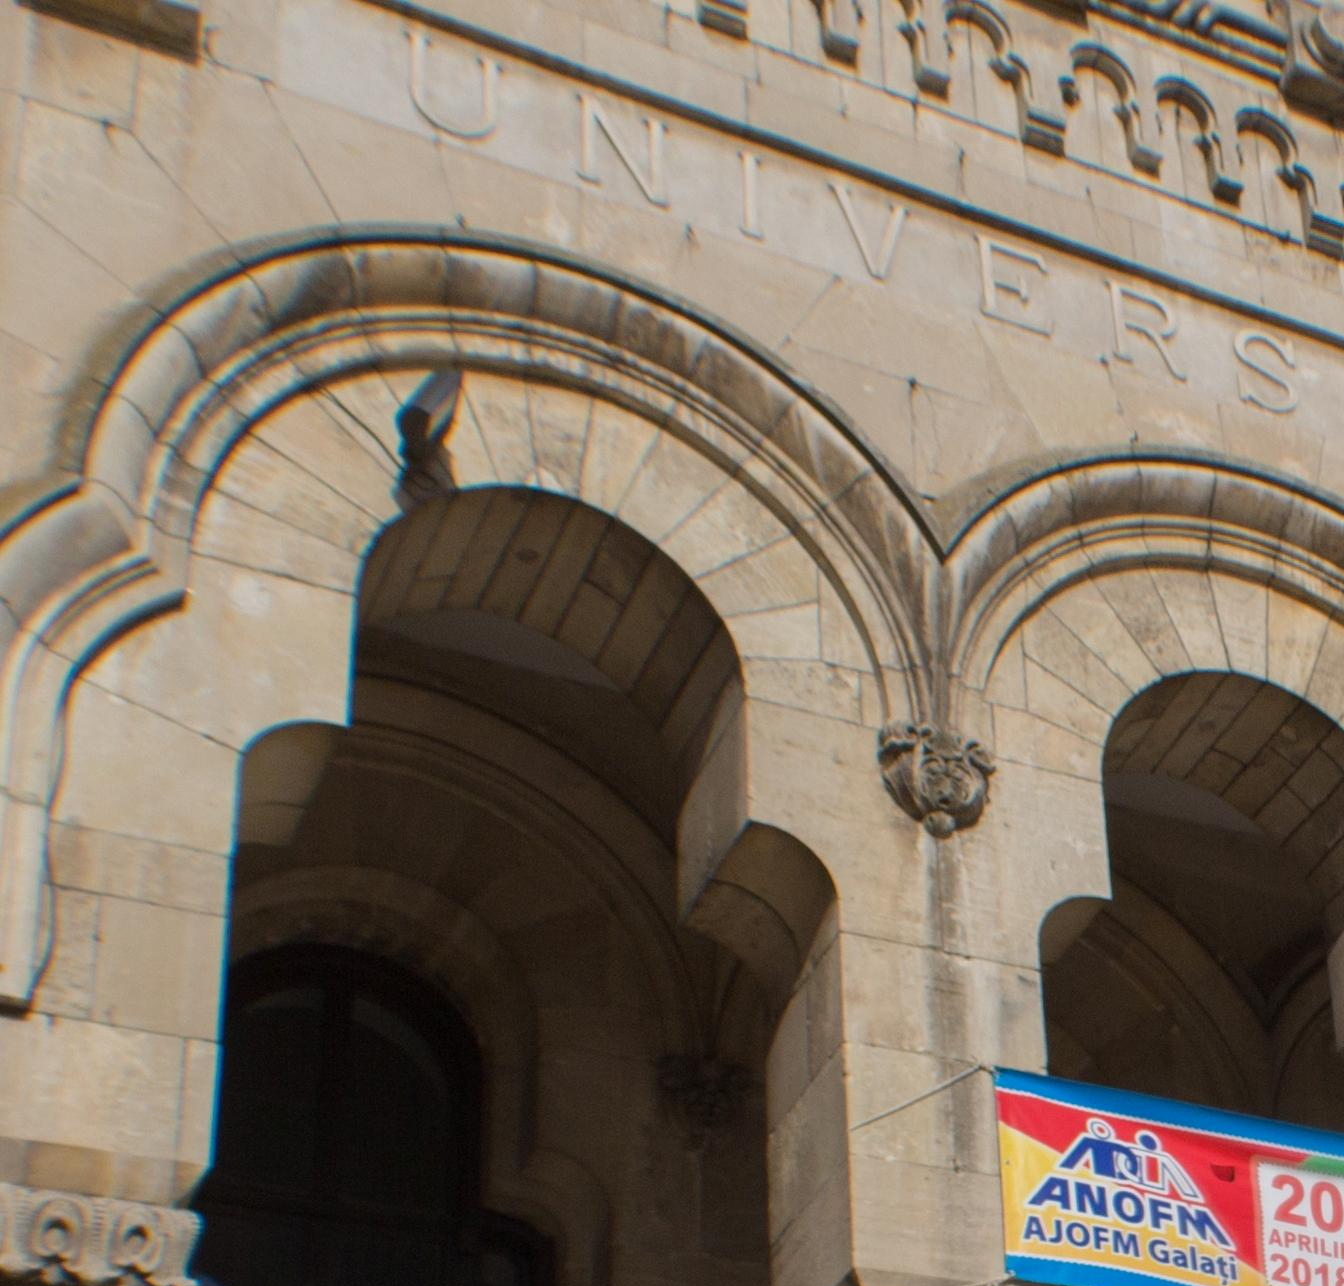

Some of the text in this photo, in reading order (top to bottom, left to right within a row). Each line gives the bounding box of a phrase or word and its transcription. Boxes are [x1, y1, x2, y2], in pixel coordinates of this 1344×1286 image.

[1027, 1176, 1233, 1248] ANOFM
[1271, 1174, 1344, 1233] 20
[1023, 1216, 1140, 1258] AJOFM
